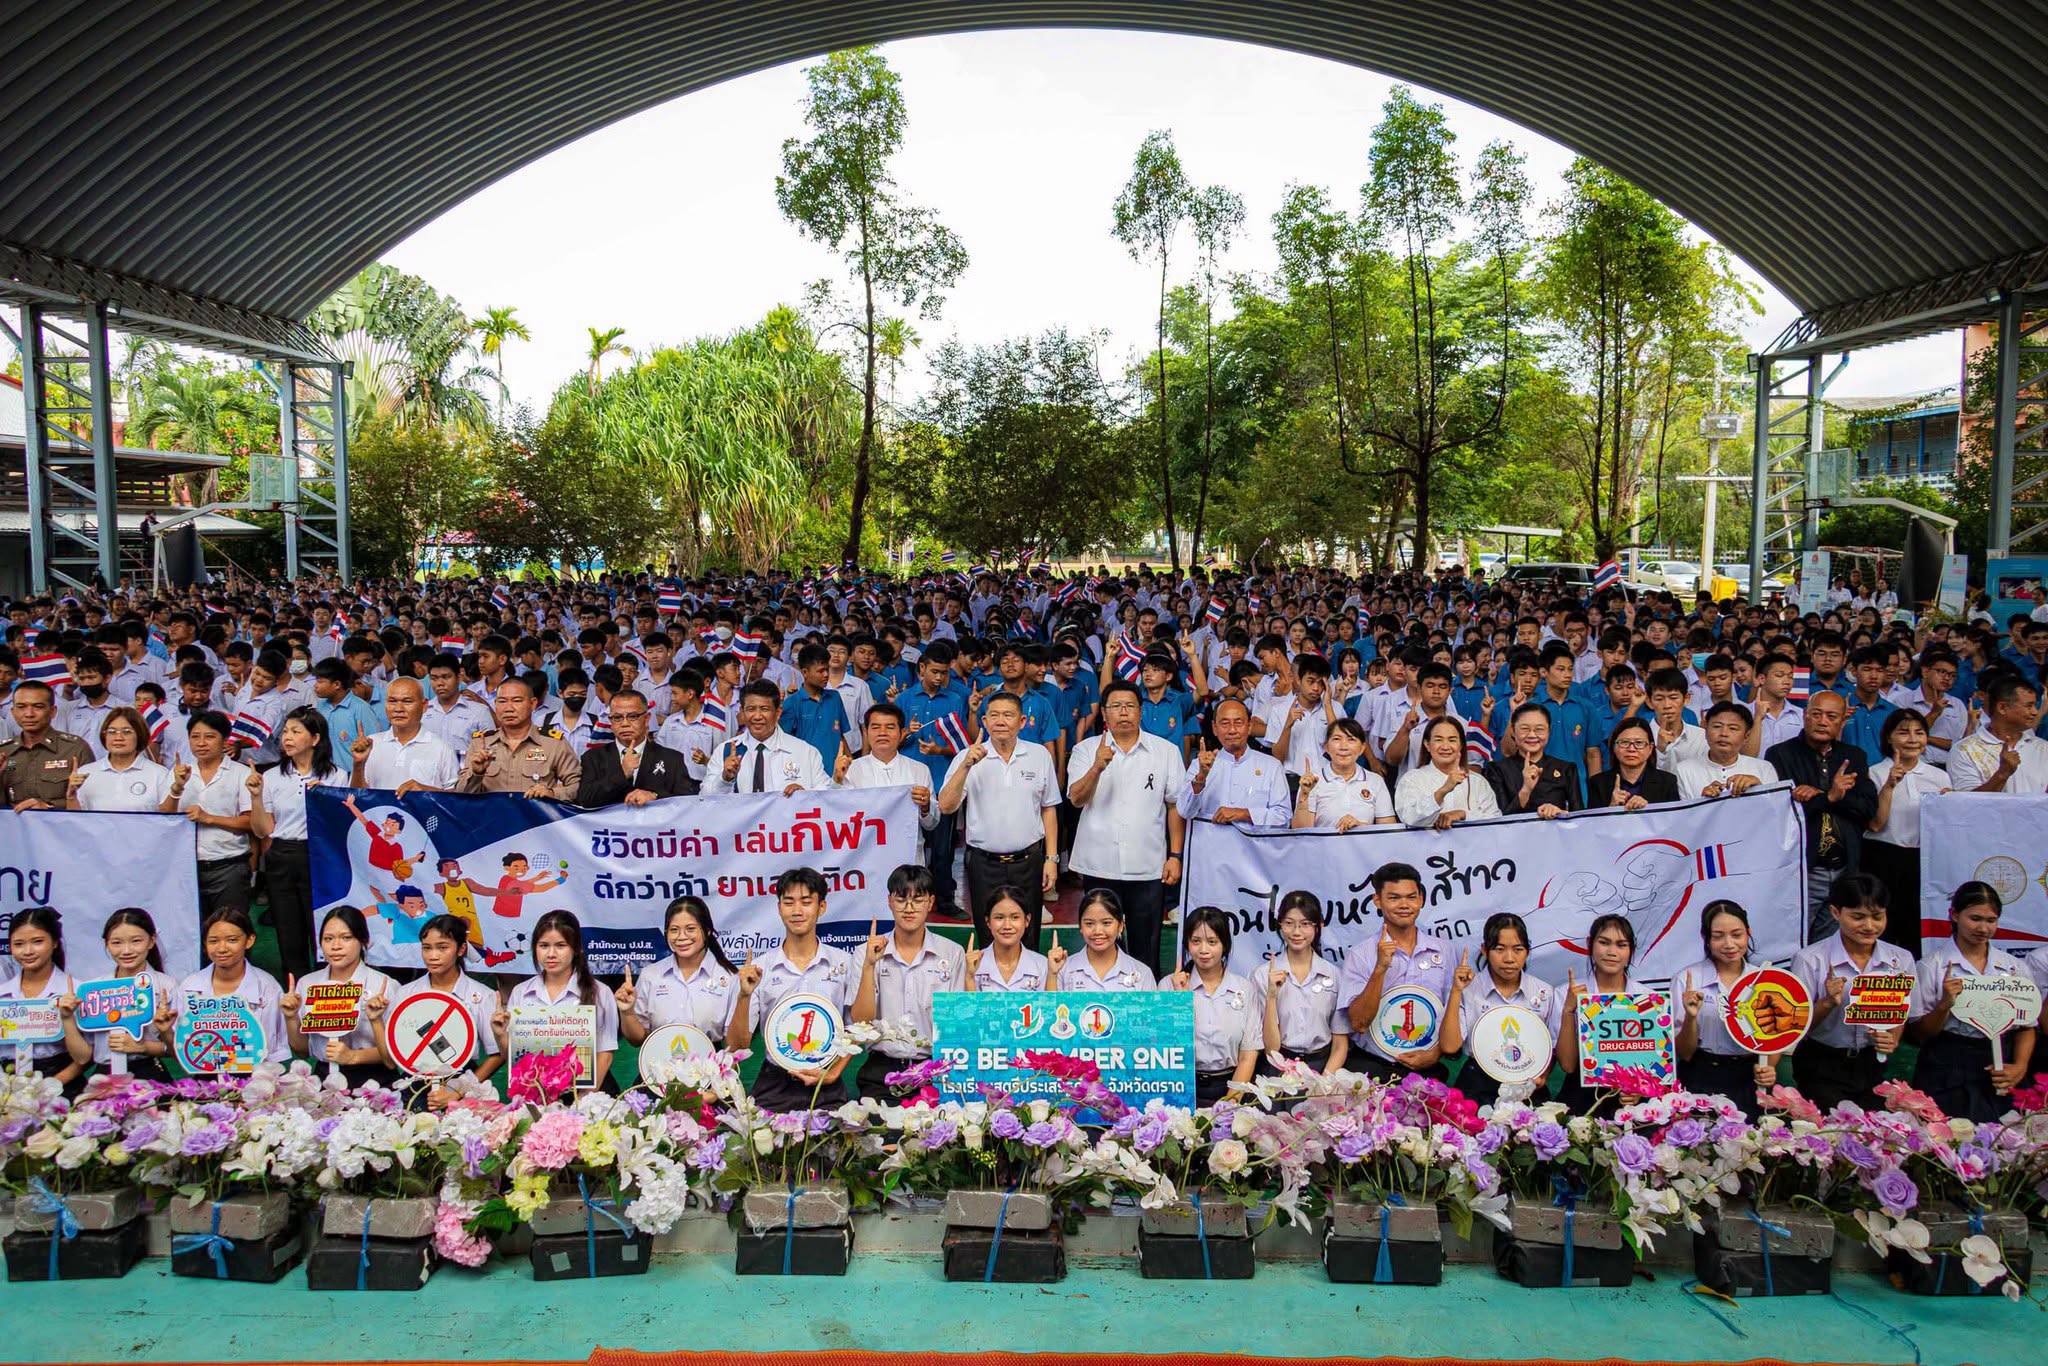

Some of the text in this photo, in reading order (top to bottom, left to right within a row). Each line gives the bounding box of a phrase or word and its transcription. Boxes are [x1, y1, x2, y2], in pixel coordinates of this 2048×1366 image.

[592, 807, 887, 859] ชีวิตมีค่า เล่นกีฬา
[593, 871, 710, 900] ดีกว่าค้า
[587, 940, 653, 950] สำนักงาน ป.ป.ส.
[587, 951, 657, 962] กระทรวงยุติธรรม
[193, 1018, 248, 1030] ยาเสพติด
[1598, 1018, 1655, 1039] STOP
[1599, 1041, 1655, 1051] DRUG ABUSE
[940, 1047, 969, 1070] TO
[977, 1047, 1009, 1070] BE
[1133, 1047, 1185, 1070] ONE
[1108, 1076, 1185, 1093] จังหวัดตราด
